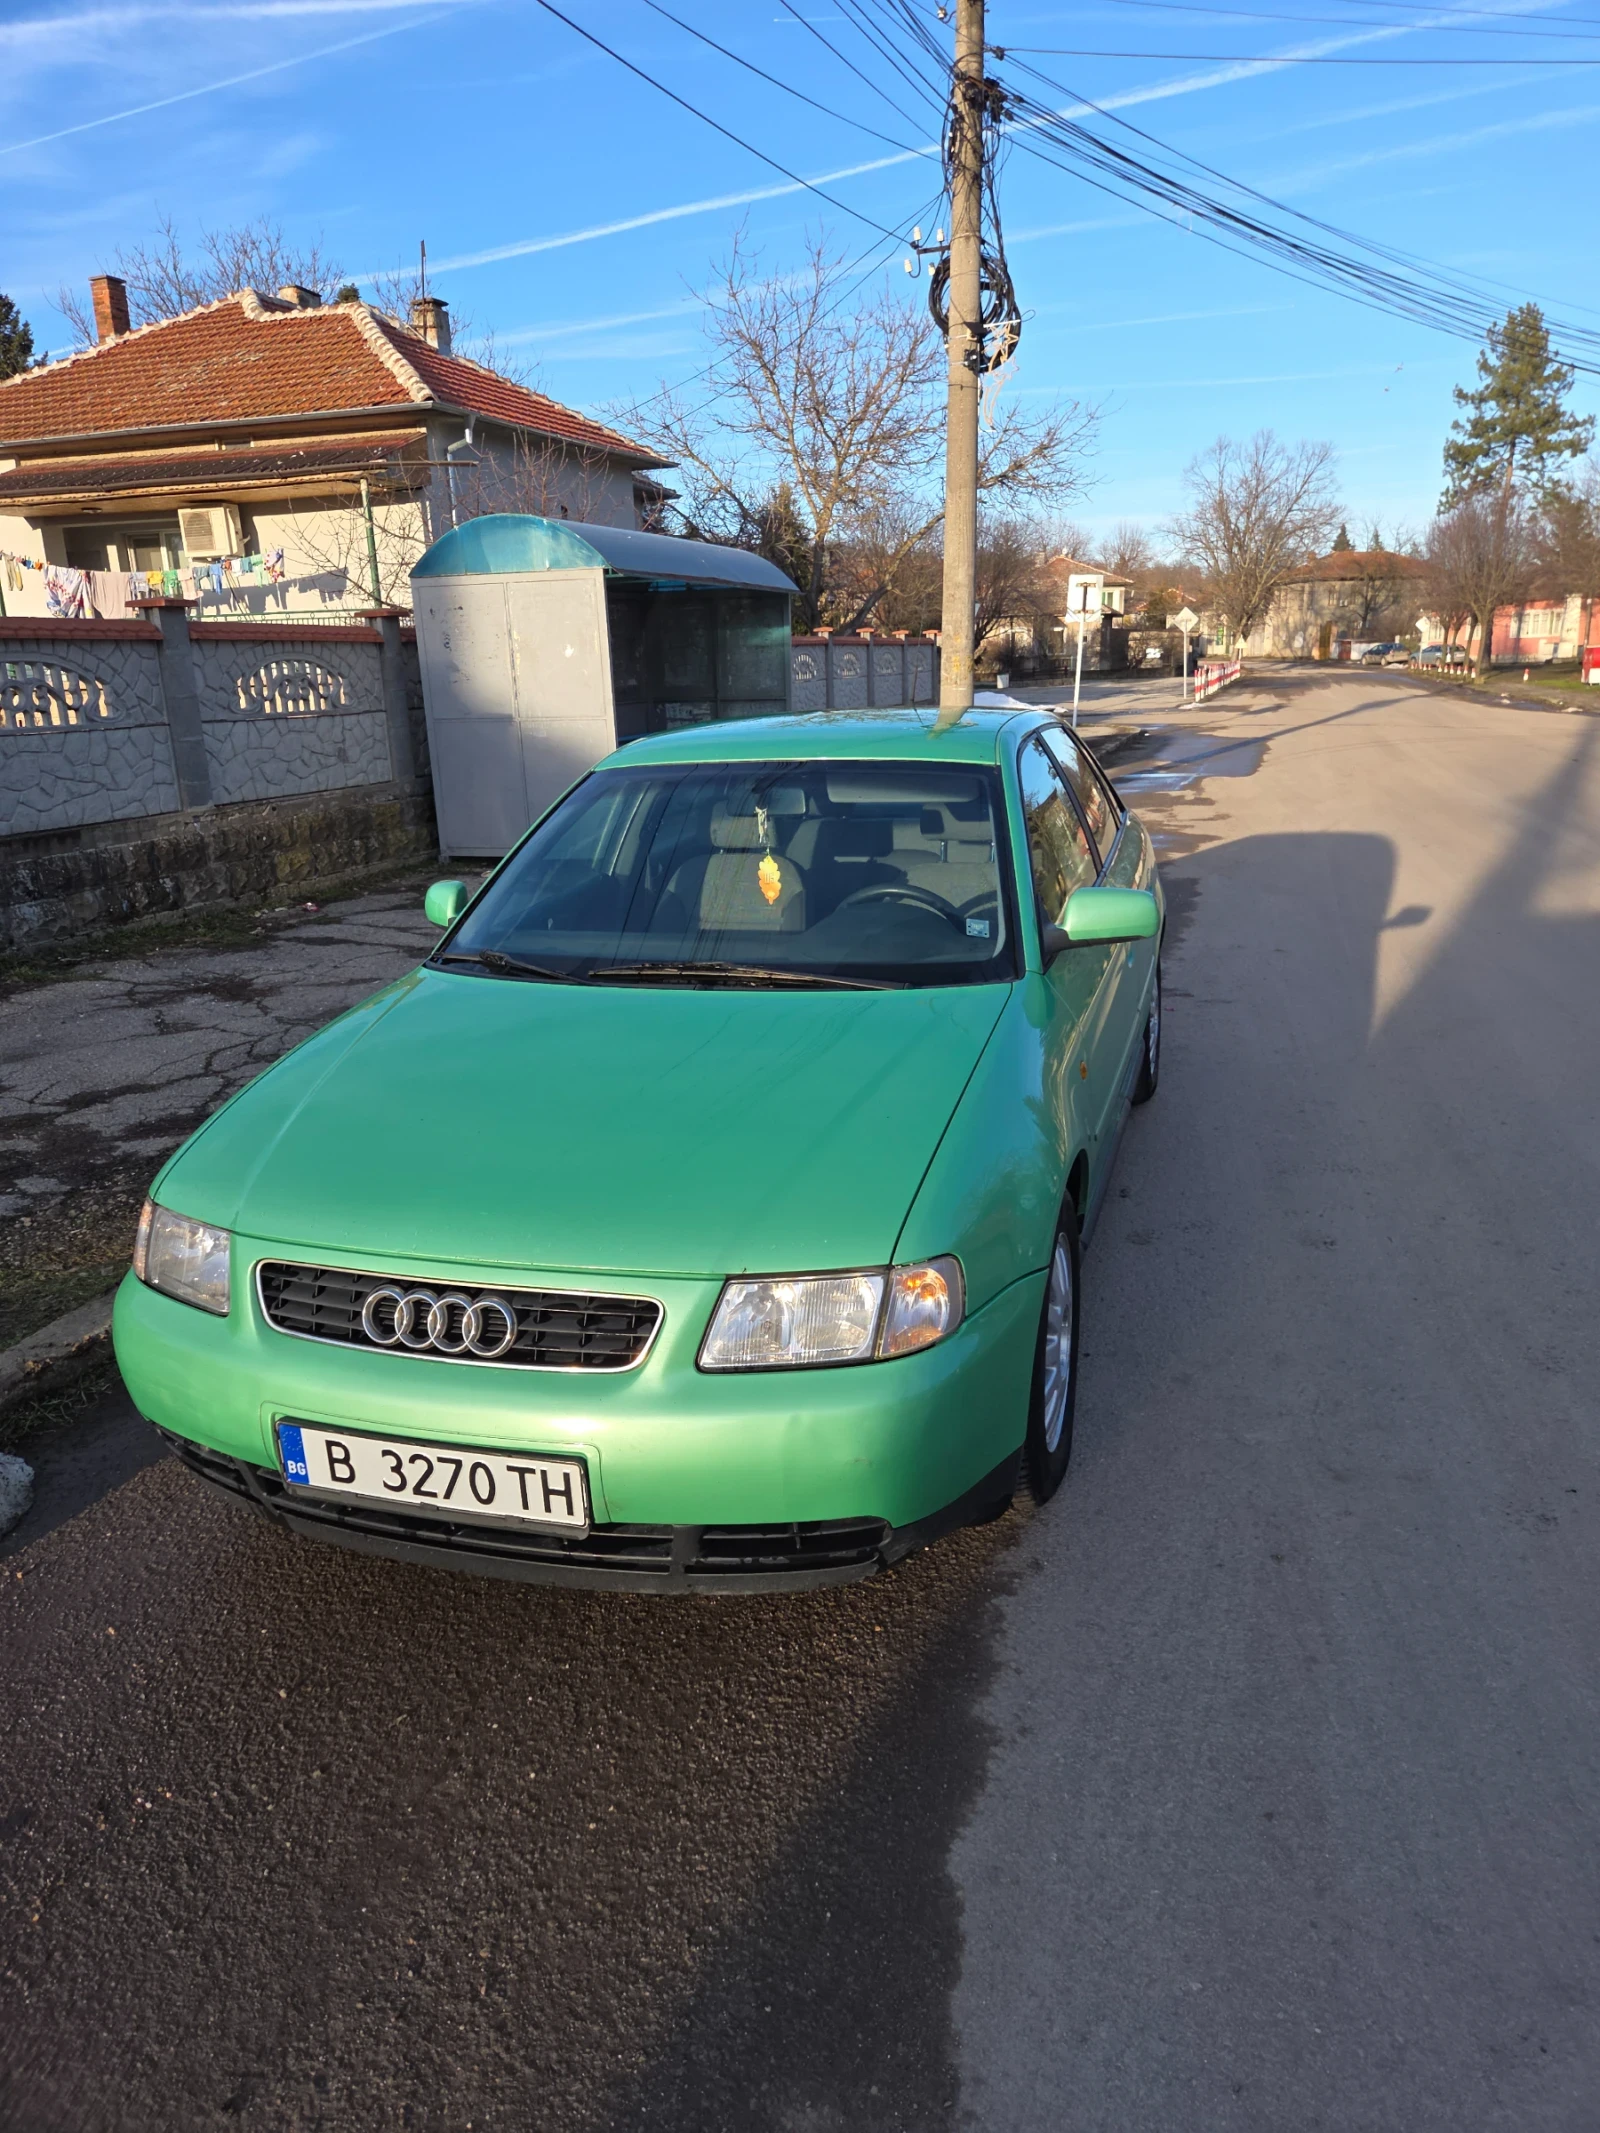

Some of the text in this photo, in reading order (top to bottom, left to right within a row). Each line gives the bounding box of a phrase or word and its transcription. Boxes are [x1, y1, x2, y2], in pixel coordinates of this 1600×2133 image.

[287, 1460, 306, 1475] BG
[324, 1439, 575, 1517] B 3270 TH
